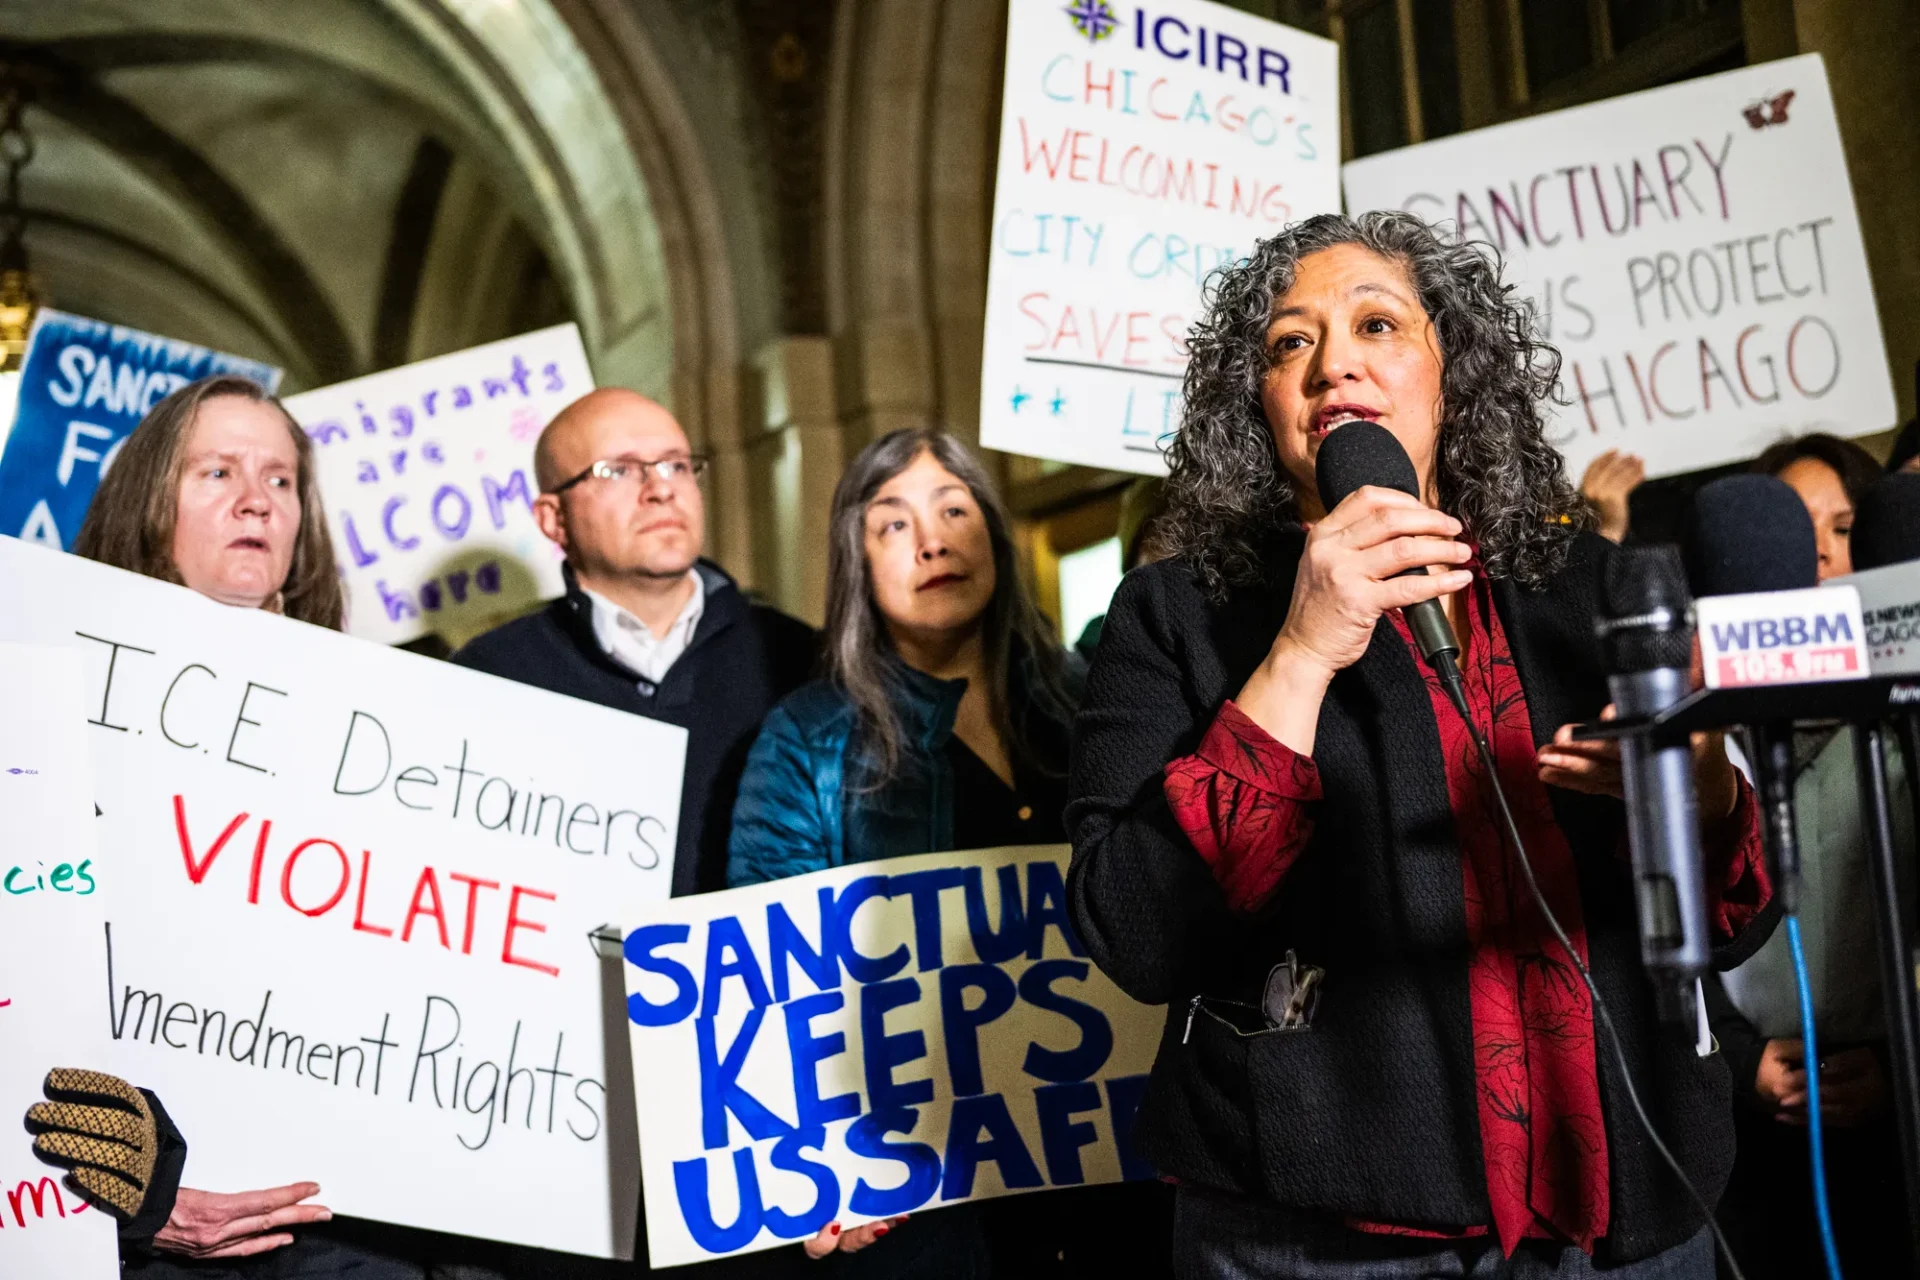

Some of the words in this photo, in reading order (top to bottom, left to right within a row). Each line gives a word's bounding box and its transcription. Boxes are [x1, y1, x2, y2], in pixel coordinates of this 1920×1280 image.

[1134, 8, 1292, 94] ICIRR
[1041, 53, 1317, 160] CHICAGO'S
[1018, 116, 1292, 223] WELCOMING
[999, 208, 1104, 267] CITY
[1626, 217, 1834, 328] PROTECT
[1018, 292, 1193, 367] SAVES
[1710, 612, 1854, 652] WBBM
[75, 631, 288, 776] I.C.E.
[334, 710, 667, 870] Detainers
[3, 858, 96, 895] cies
[173, 795, 560, 977] VIOLATE
[622, 862, 1089, 1027] SANCTUA
[408, 996, 606, 1151] Rights
[695, 959, 1114, 1150] KEEPS
[672, 1125, 841, 1254] US
